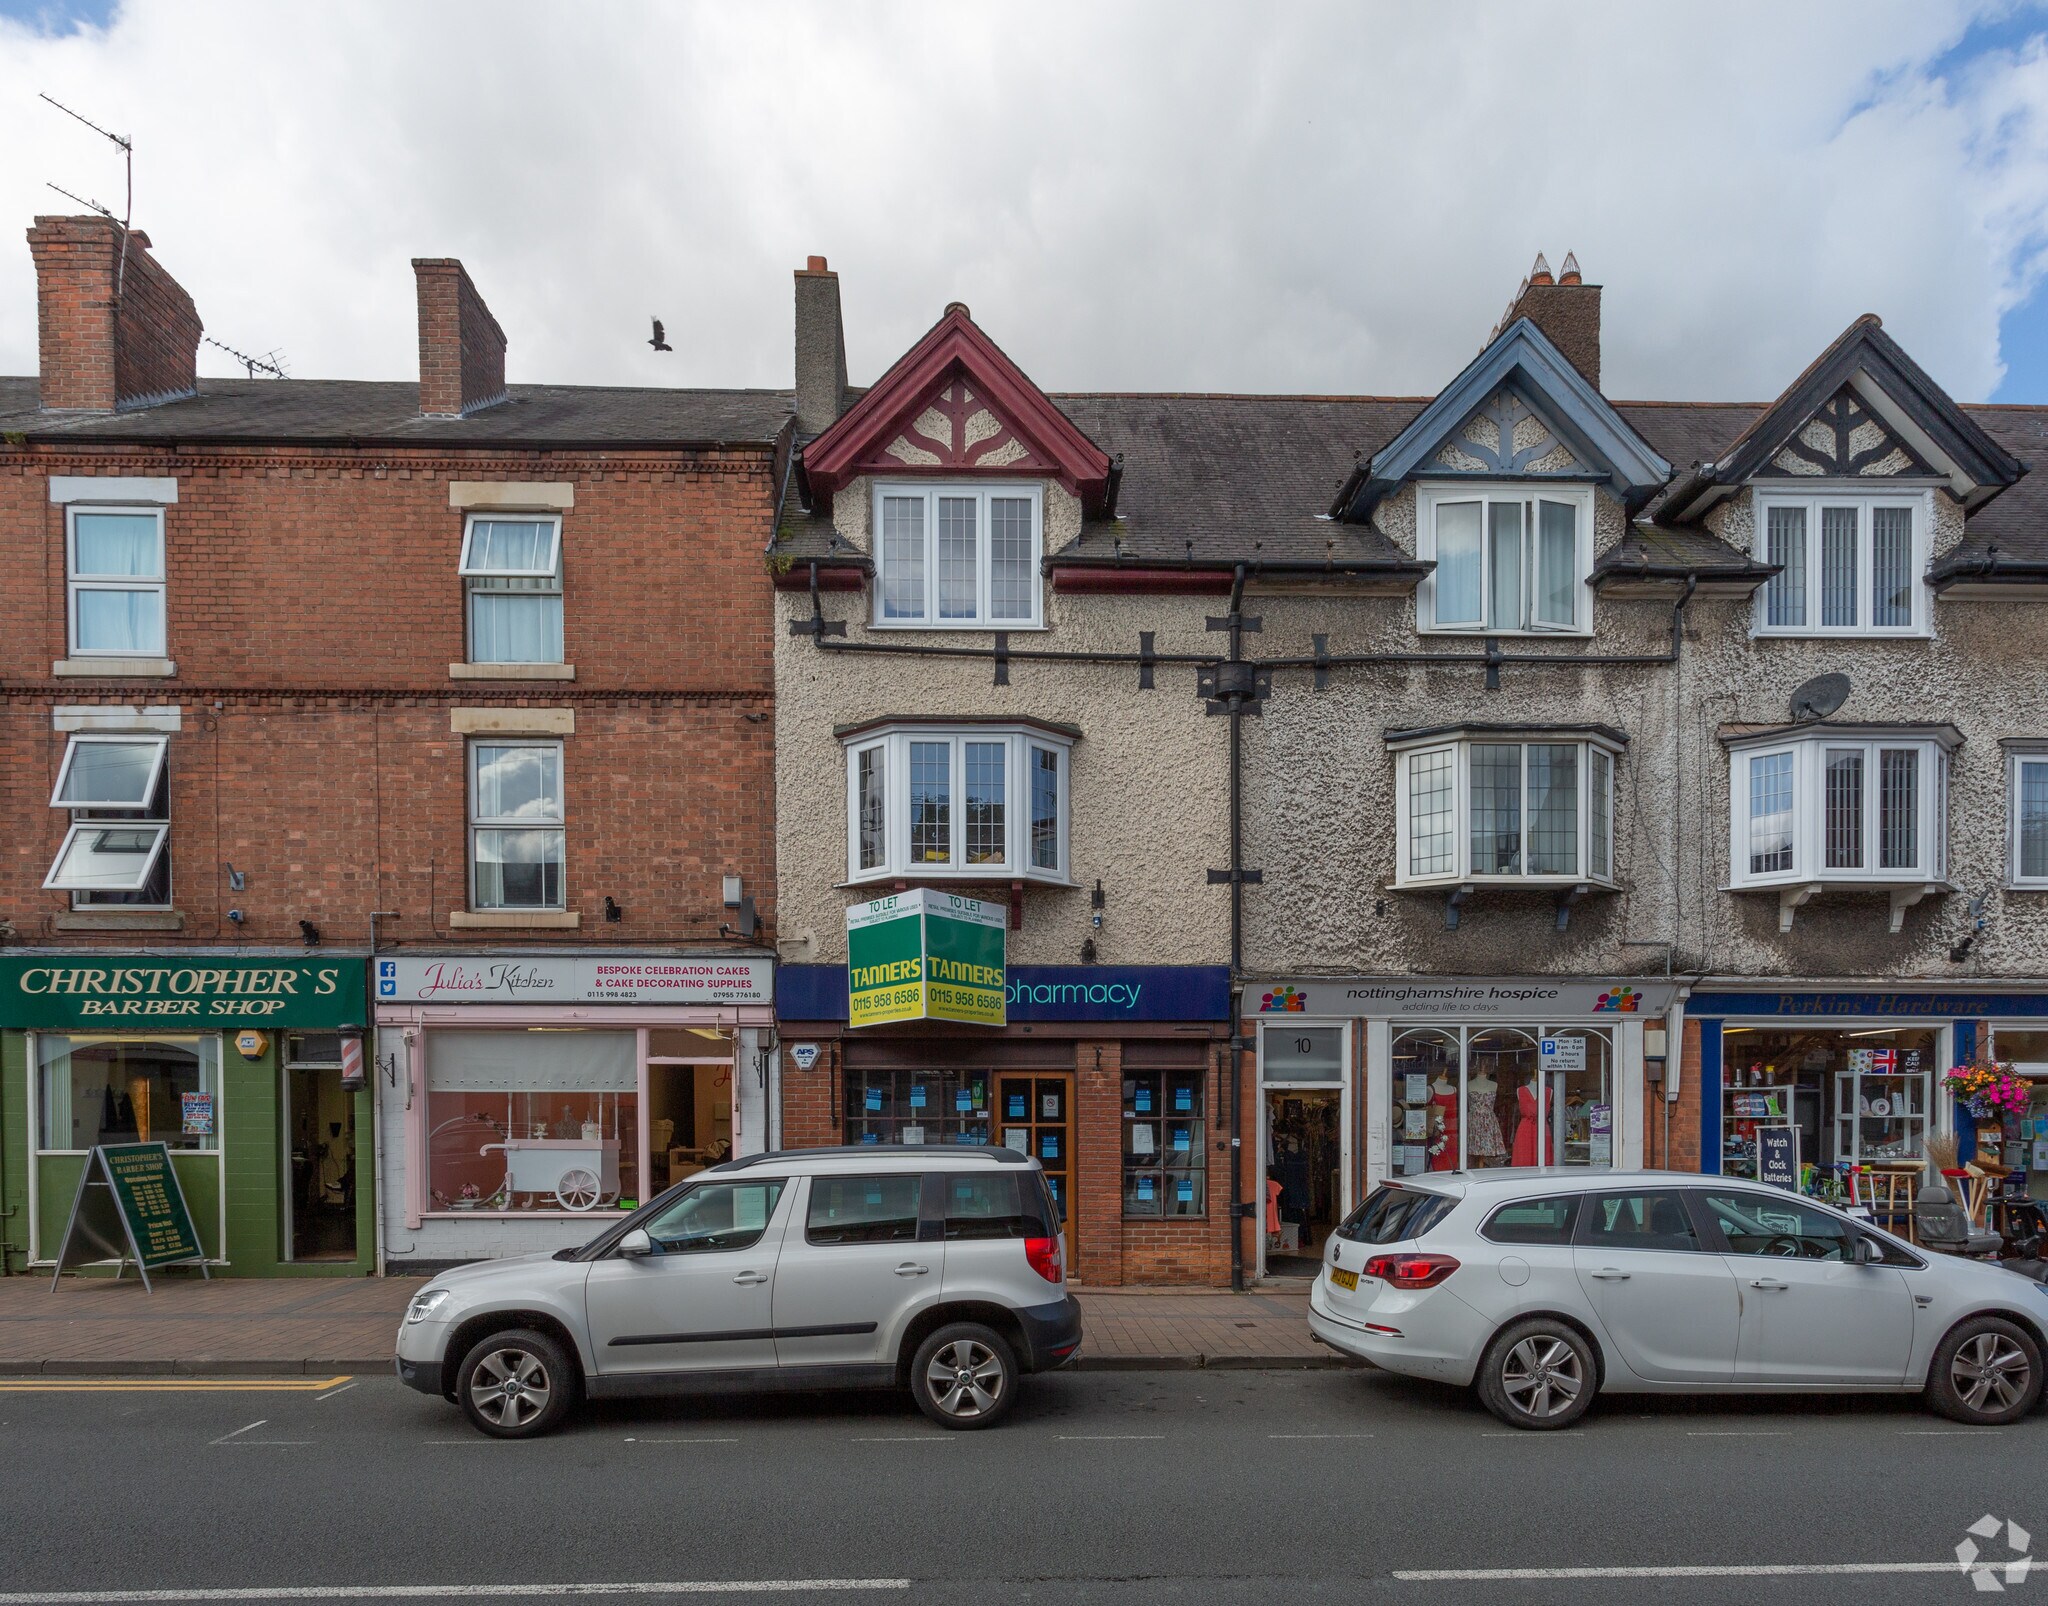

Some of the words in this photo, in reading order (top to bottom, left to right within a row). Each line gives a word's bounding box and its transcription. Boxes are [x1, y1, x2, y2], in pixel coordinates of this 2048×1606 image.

[869, 901, 880, 913] TO
[883, 896, 898, 910] LET
[948, 896, 961, 908] TO
[965, 899, 981, 912] LET
[597, 966, 642, 975] BESPOKE
[645, 966, 713, 975] CELEBRATION
[716, 966, 750, 975] CAKES
[851, 957, 921, 988] TANNERS
[927, 956, 1004, 986] TANNERS
[418, 962, 484, 999] Julia's
[485, 963, 555, 996] Kitchen
[595, 979, 602, 987] &
[606, 979, 633, 988] CAKE
[637, 979, 705, 988] DECORATING
[707, 979, 752, 988] SUPPLIES
[853, 996, 871, 1011] 0115
[874, 992, 891, 1008] 958
[894, 988, 919, 1004] 6586
[930, 988, 953, 1003] 0115
[955, 991, 974, 1007] 958
[977, 994, 1002, 1010] 6586
[1347, 986, 1484, 1000] nottinghamshire
[1489, 987, 1558, 1000] hospice
[79, 1000, 200, 1015] BARBER
[208, 1000, 285, 1015] SHOP
[1402, 1002, 1439, 1012] adding
[1442, 1002, 1457, 1012] life
[1460, 1003, 1470, 1011] to
[1473, 1002, 1499, 1012] days
[1875, 995, 1988, 1014] Hardware
[1295, 1037, 1311, 1053] 10
[1767, 1138, 1788, 1147] Watch
[1774, 1150, 1780, 1158] &
[116, 1164, 144, 1174] BARBER
[145, 1162, 163, 1171] SHOP
[1768, 1160, 1787, 1170] Clock
[1763, 1172, 1792, 1183] Batteries
